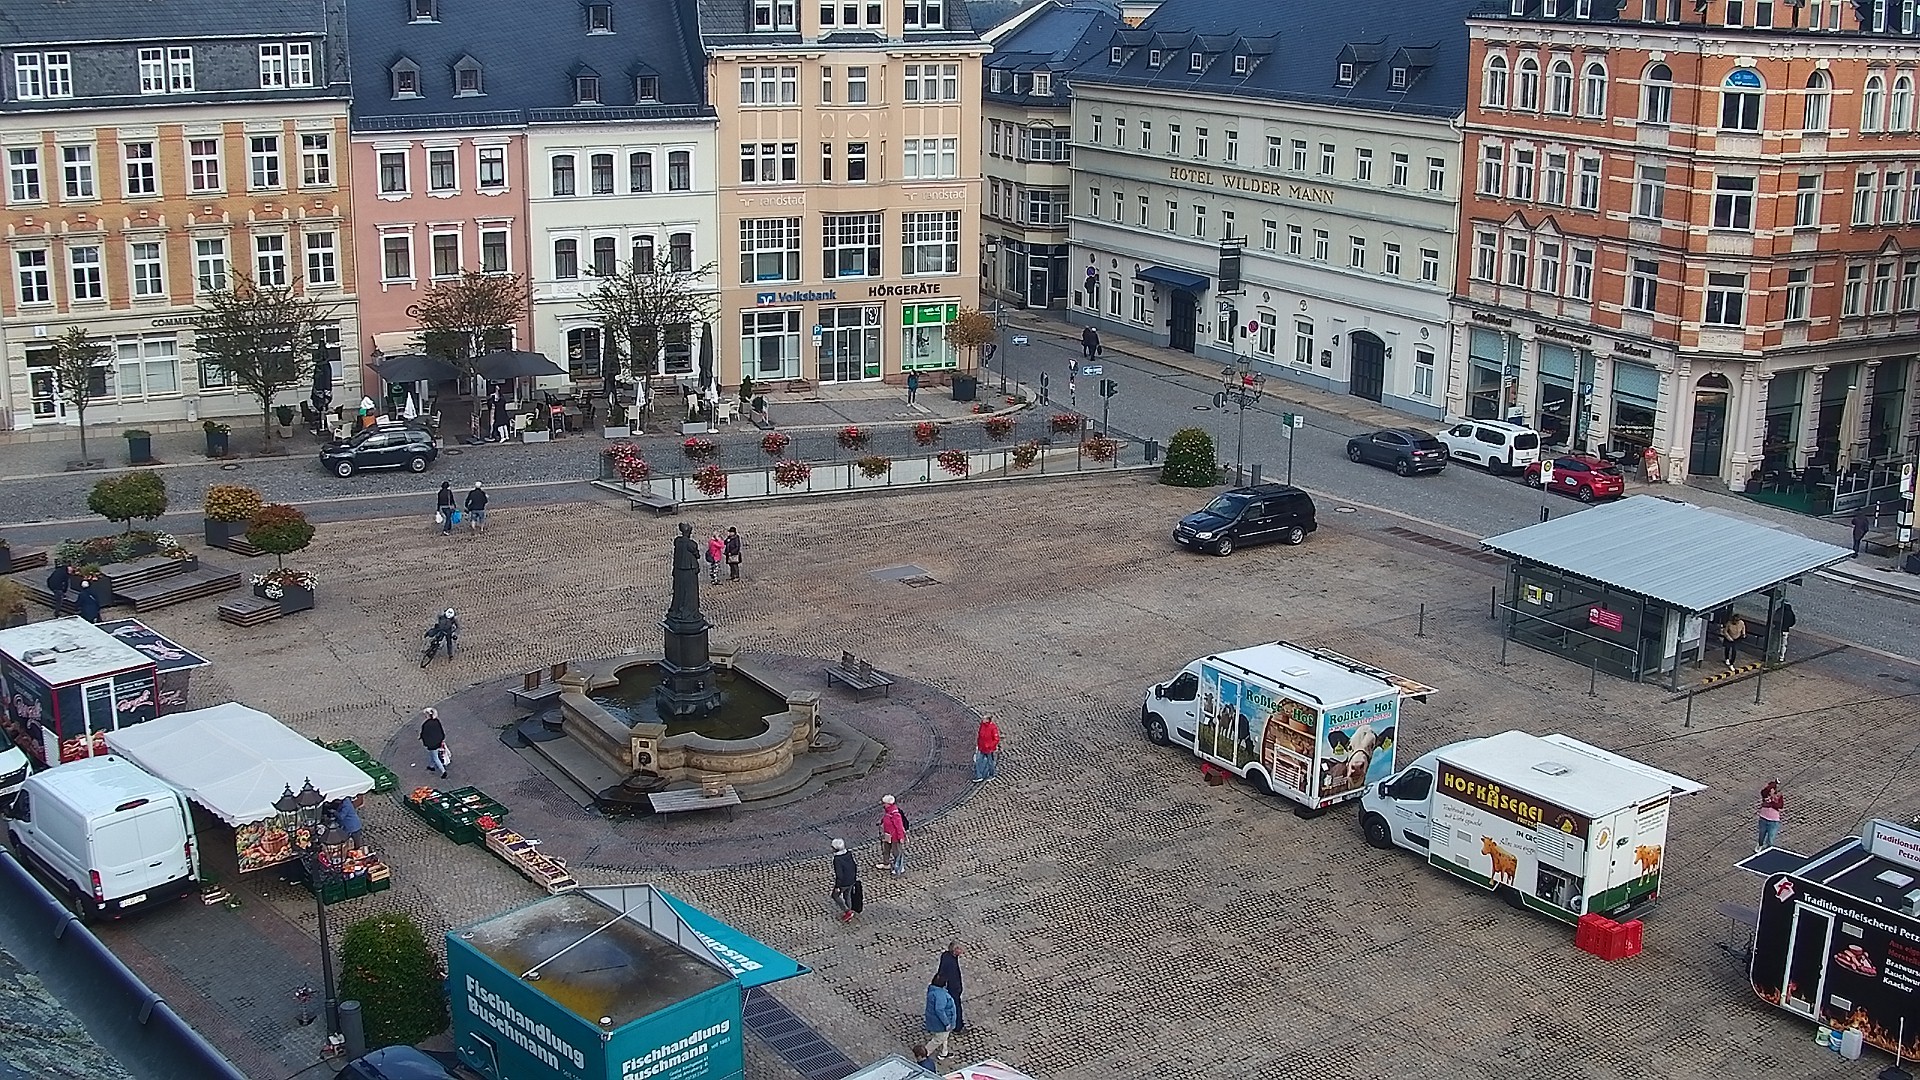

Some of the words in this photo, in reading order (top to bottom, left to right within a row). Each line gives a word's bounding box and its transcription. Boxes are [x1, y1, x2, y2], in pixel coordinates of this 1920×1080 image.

[922, 188, 965, 200] randstad
[1169, 166, 1214, 186] HOTEL
[1222, 174, 1281, 196] WILDER
[1288, 184, 1335, 205] MANN
[759, 194, 805, 206] randstad
[778, 289, 837, 302] Volksbank
[868, 283, 941, 297] HÖRGERÄTE
[1374, 700, 1394, 714] Hof
[1293, 709, 1315, 727] Hof
[1802, 892, 1898, 934] Traditionsfleischerei
[1882, 976, 1914, 993] Knacker
[465, 974, 585, 1070] Fischhandlung
[467, 994, 560, 1071] Buschmann
[622, 1019, 730, 1075] Fischhandlung
